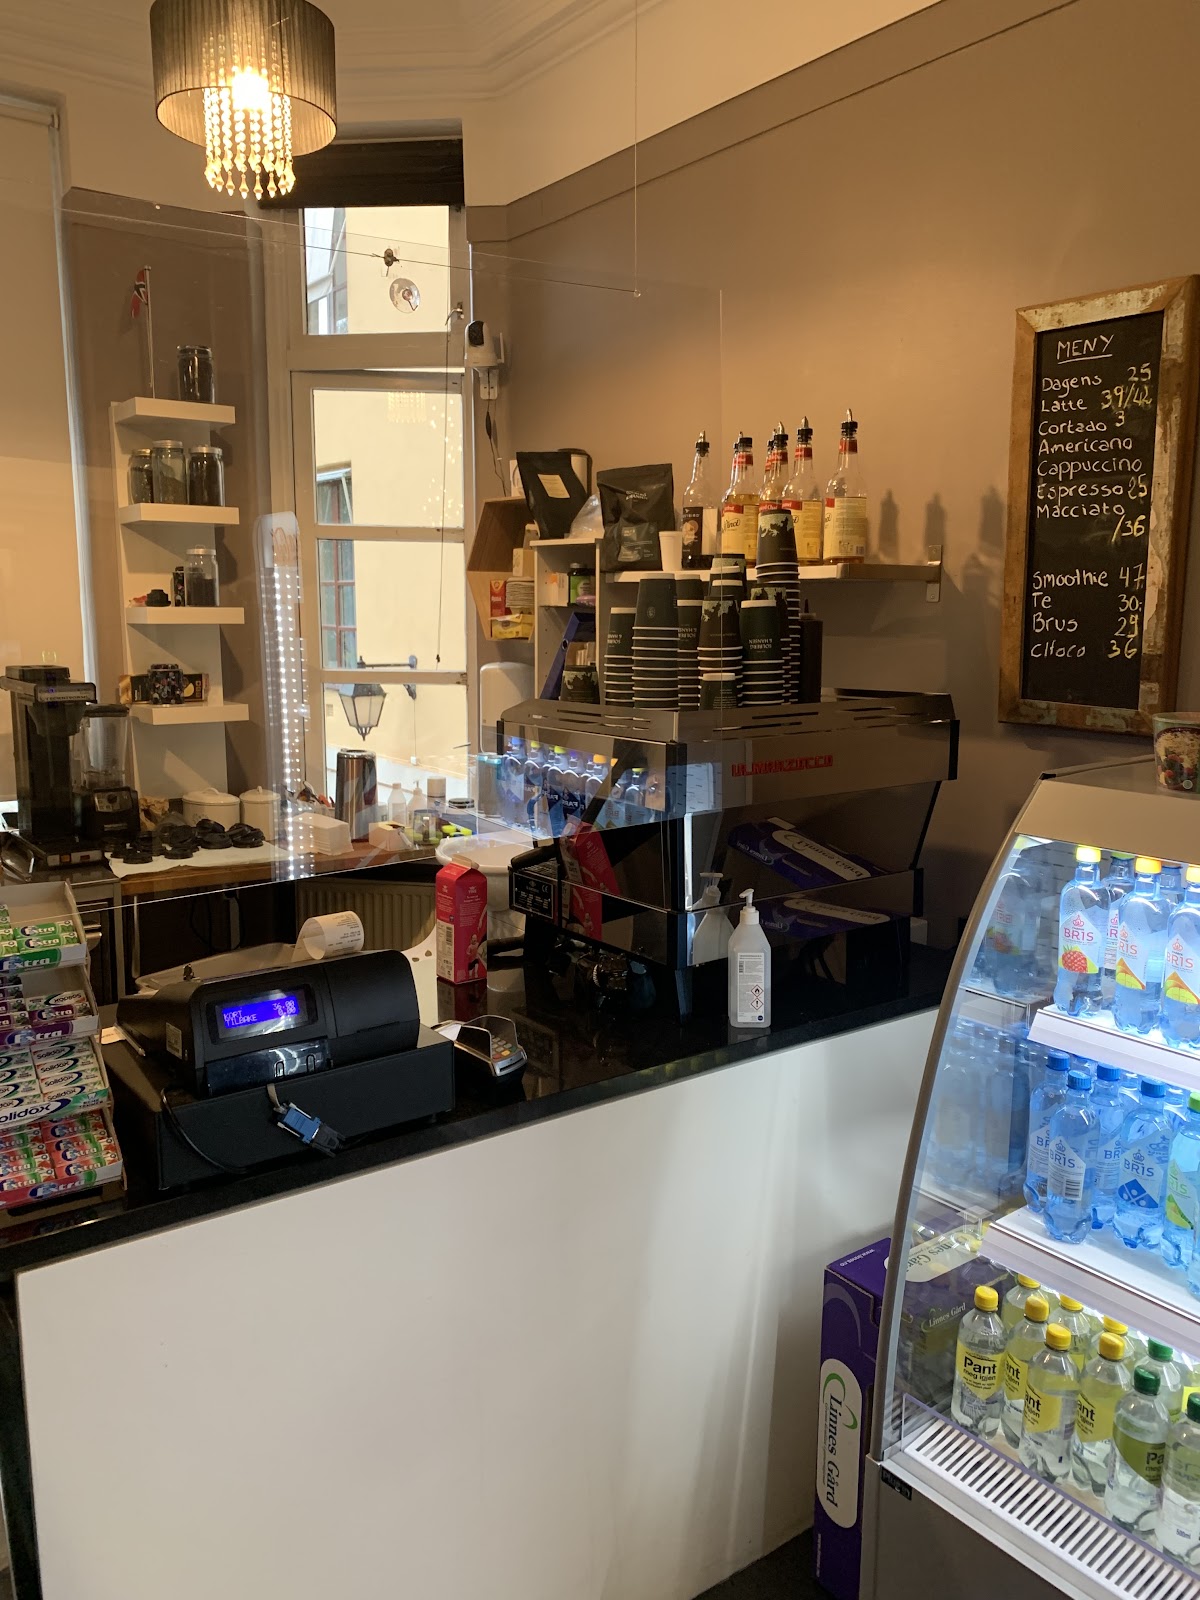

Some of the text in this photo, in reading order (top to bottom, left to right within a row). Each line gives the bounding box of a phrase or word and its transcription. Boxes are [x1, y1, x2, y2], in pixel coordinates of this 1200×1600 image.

[1056, 333, 1114, 360] MENY
[1041, 363, 1151, 398] Dagens 25
[1041, 398, 1088, 413] Latte
[1038, 420, 1107, 436] Cortado
[1038, 436, 1133, 456] Americano
[1037, 458, 1143, 481] Cappuccino
[1036, 482, 1124, 507] Espresso
[1036, 502, 1126, 519] Macciato
[1032, 568, 1109, 590] Smoothie
[1032, 591, 1052, 609] Te
[1032, 612, 1138, 638] Brus 29
[1107, 638, 1138, 659] 36
[1064, 927, 1094, 941] BRIS
[1118, 942, 1138, 955] RIS
[3, 958, 50, 971] Extra
[1167, 951, 1194, 969] BRIS
[14, 1030, 63, 1044] Extra
[36, 1047, 67, 1060] Solidox
[40, 1060, 70, 1073] Solidox
[44, 1074, 74, 1087] Solidox
[47, 1088, 77, 1101] Solidox
[0, 1104, 51, 1123] olidox
[1049, 1148, 1076, 1168] BRIS
[1104, 1150, 1120, 1160] BR
[1124, 1158, 1154, 1177] BRIS
[37, 1179, 86, 1197] Extra
[1168, 1179, 1188, 1195] RIS
[964, 1356, 997, 1375] Pant
[1077, 1400, 1096, 1422] ant
[829, 1393, 843, 1456] Linnes
[1146, 1452, 1164, 1465] Pa
[826, 1460, 840, 1508] Gård
